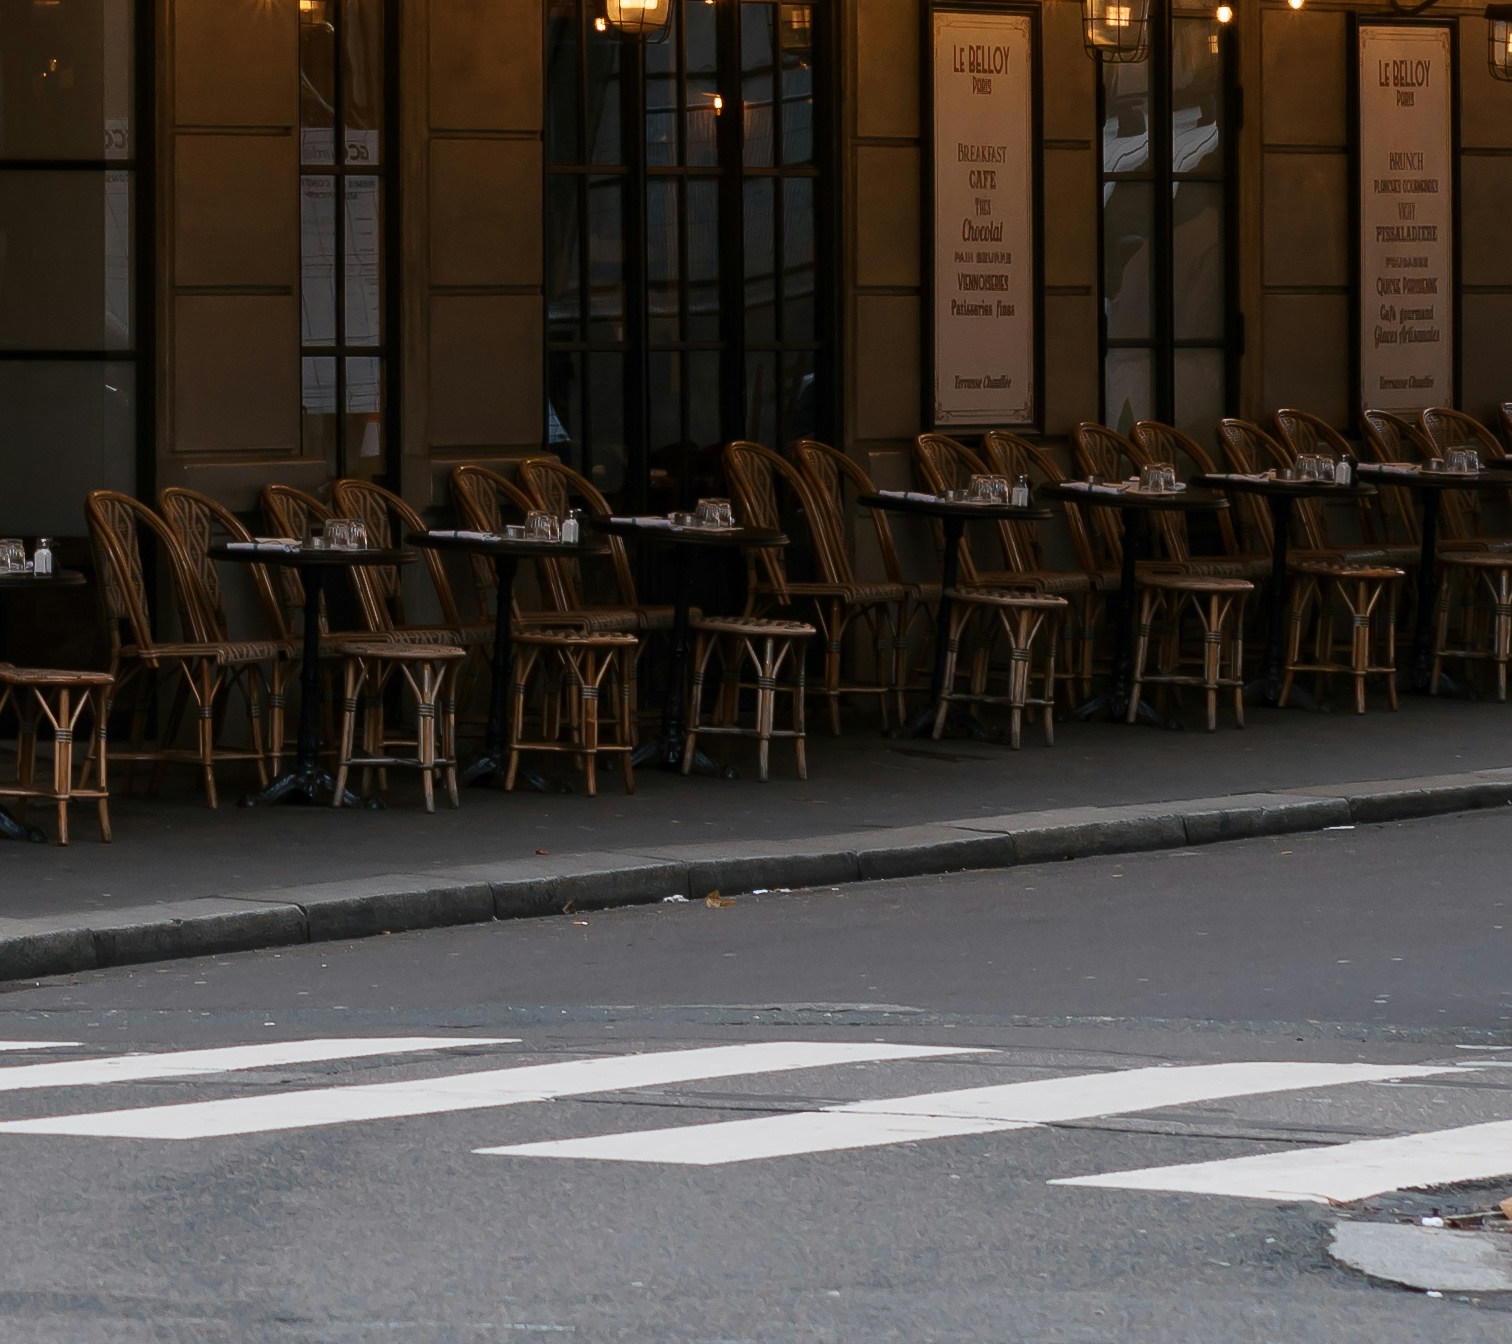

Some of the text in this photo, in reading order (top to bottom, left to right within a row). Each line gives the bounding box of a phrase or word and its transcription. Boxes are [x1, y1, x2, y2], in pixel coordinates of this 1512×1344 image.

[953, 44, 1010, 75] LE BELLOY
[1379, 59, 1431, 88] LE BELLOY
[972, 75, 992, 95] PARIS
[1396, 89, 1415, 107] PARIS
[957, 143, 1007, 163] BREAKFAST
[1389, 152, 1423, 171] BRUNCH
[957, 272, 1009, 292] VIENNOISERIES
